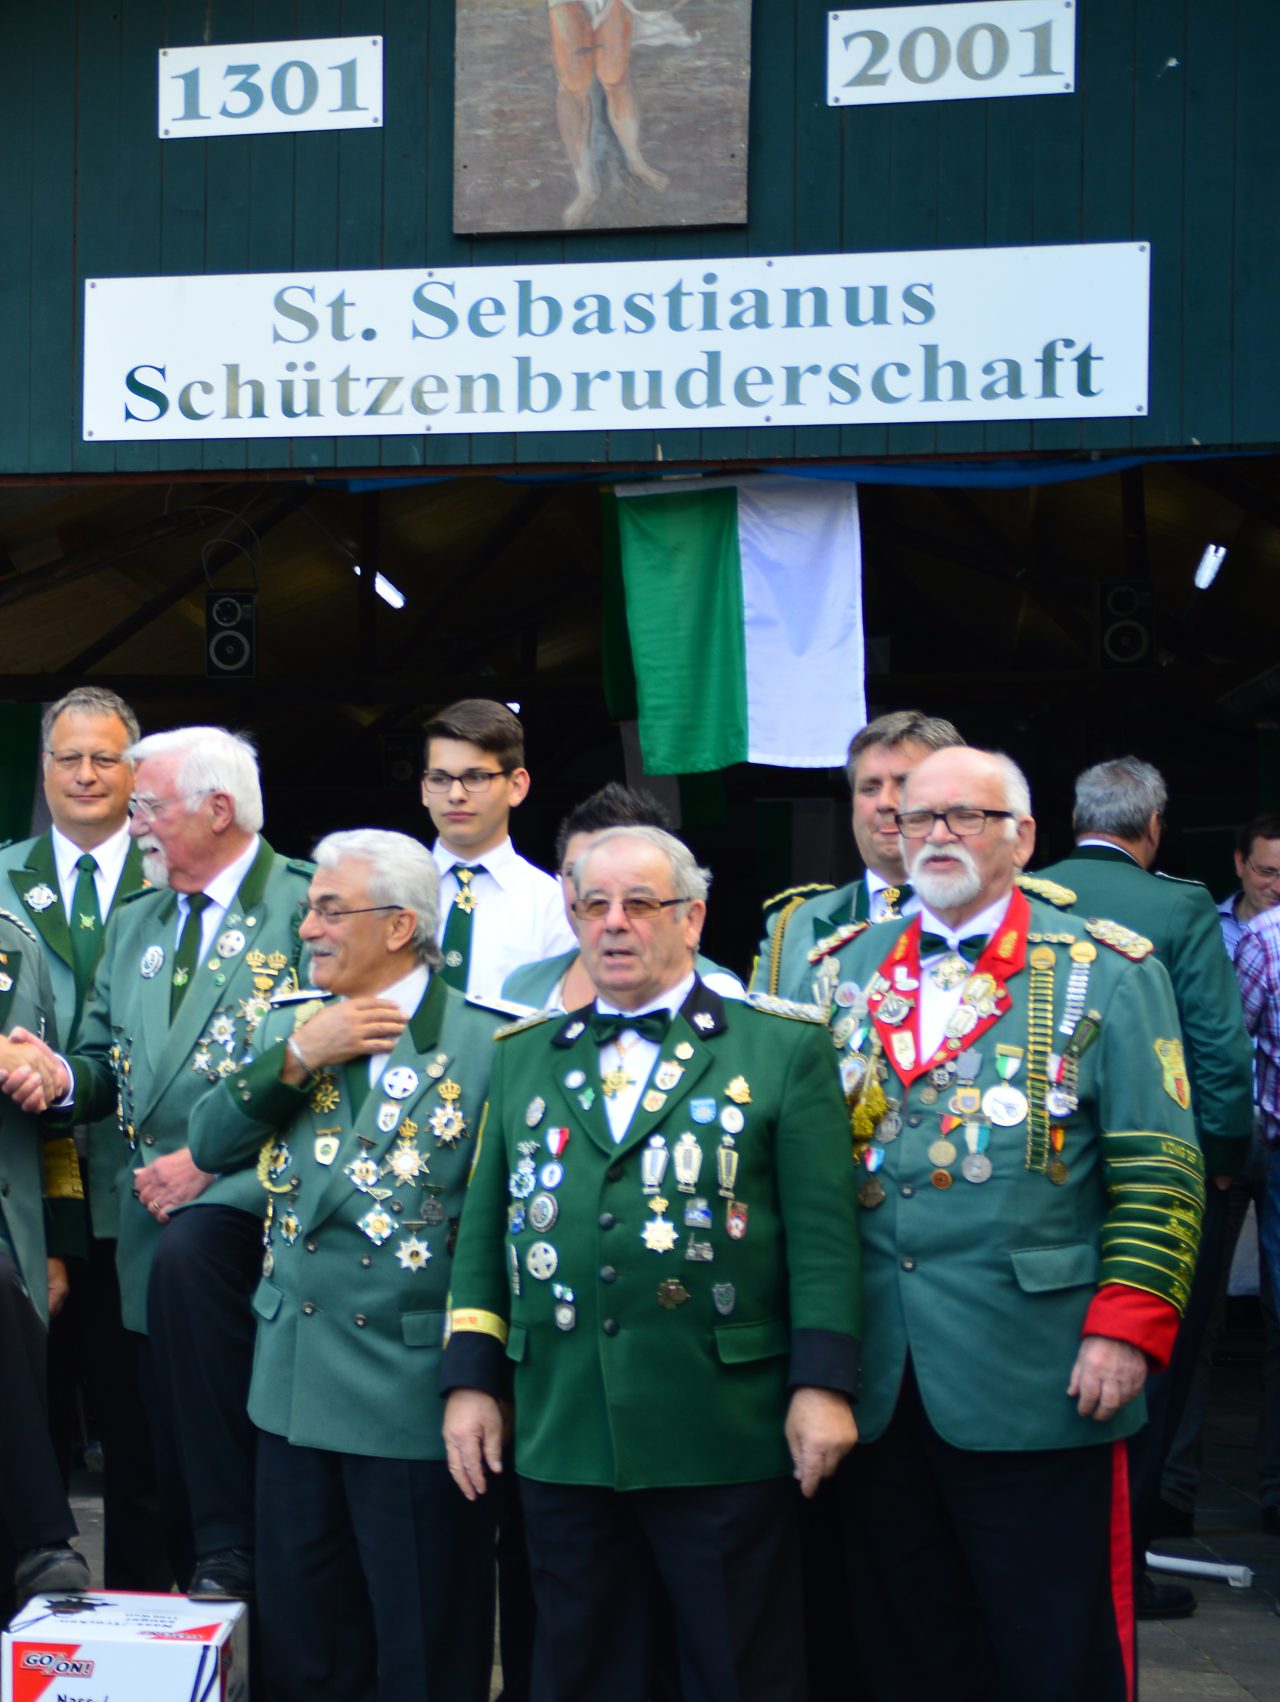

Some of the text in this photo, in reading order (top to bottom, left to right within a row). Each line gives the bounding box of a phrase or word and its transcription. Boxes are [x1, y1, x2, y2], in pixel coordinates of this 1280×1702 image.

[842, 19, 1065, 87] 2001
[171, 57, 369, 121] 1301
[272, 271, 937, 344] St. Sebastianus
[122, 337, 1105, 424] Schützenbruderschaft
